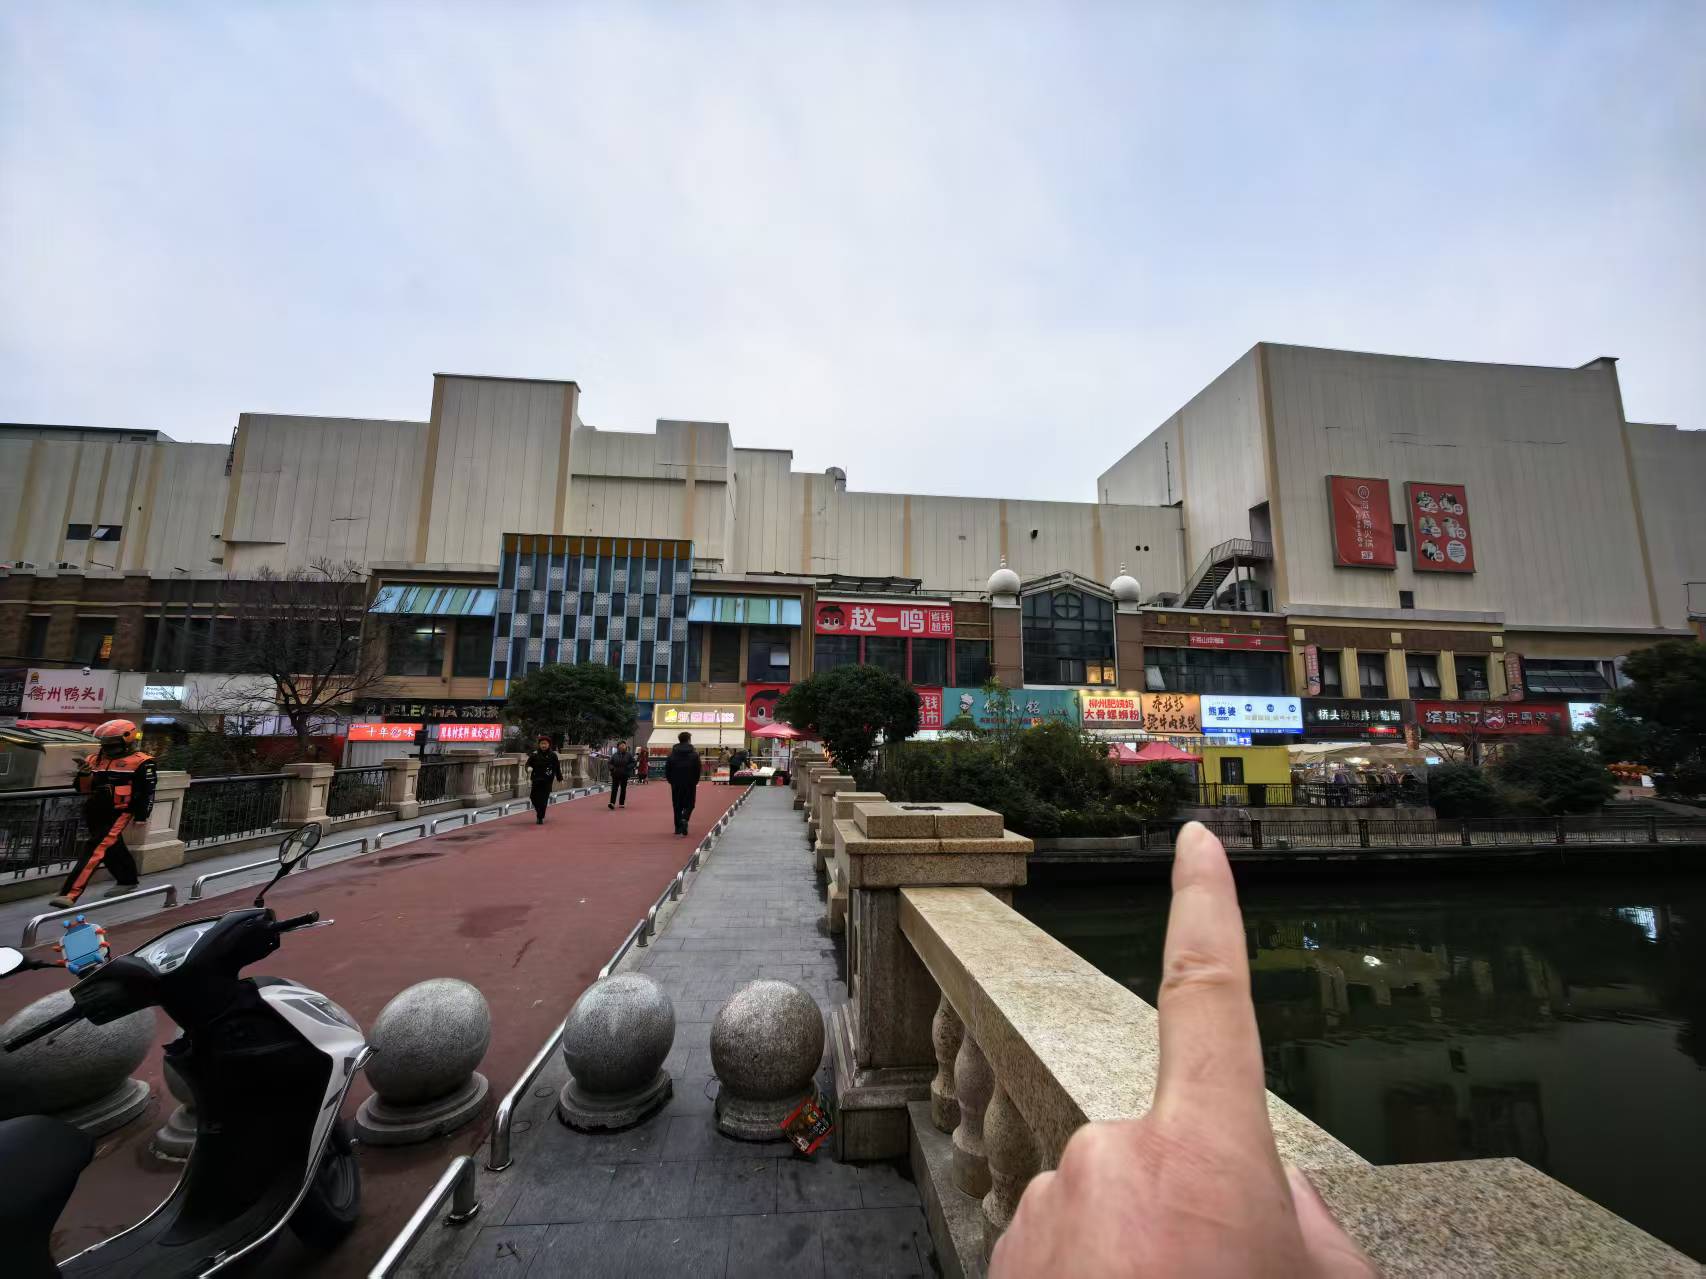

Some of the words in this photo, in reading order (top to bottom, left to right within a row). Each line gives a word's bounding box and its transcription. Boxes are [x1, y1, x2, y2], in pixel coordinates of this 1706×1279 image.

[850, 607, 926, 633] 赵一鸣
[1085, 709, 1139, 720] 大骨螺蛳粉
[1208, 706, 1236, 716] 熊麻婆
[1426, 711, 1479, 724] 塔斯汀
